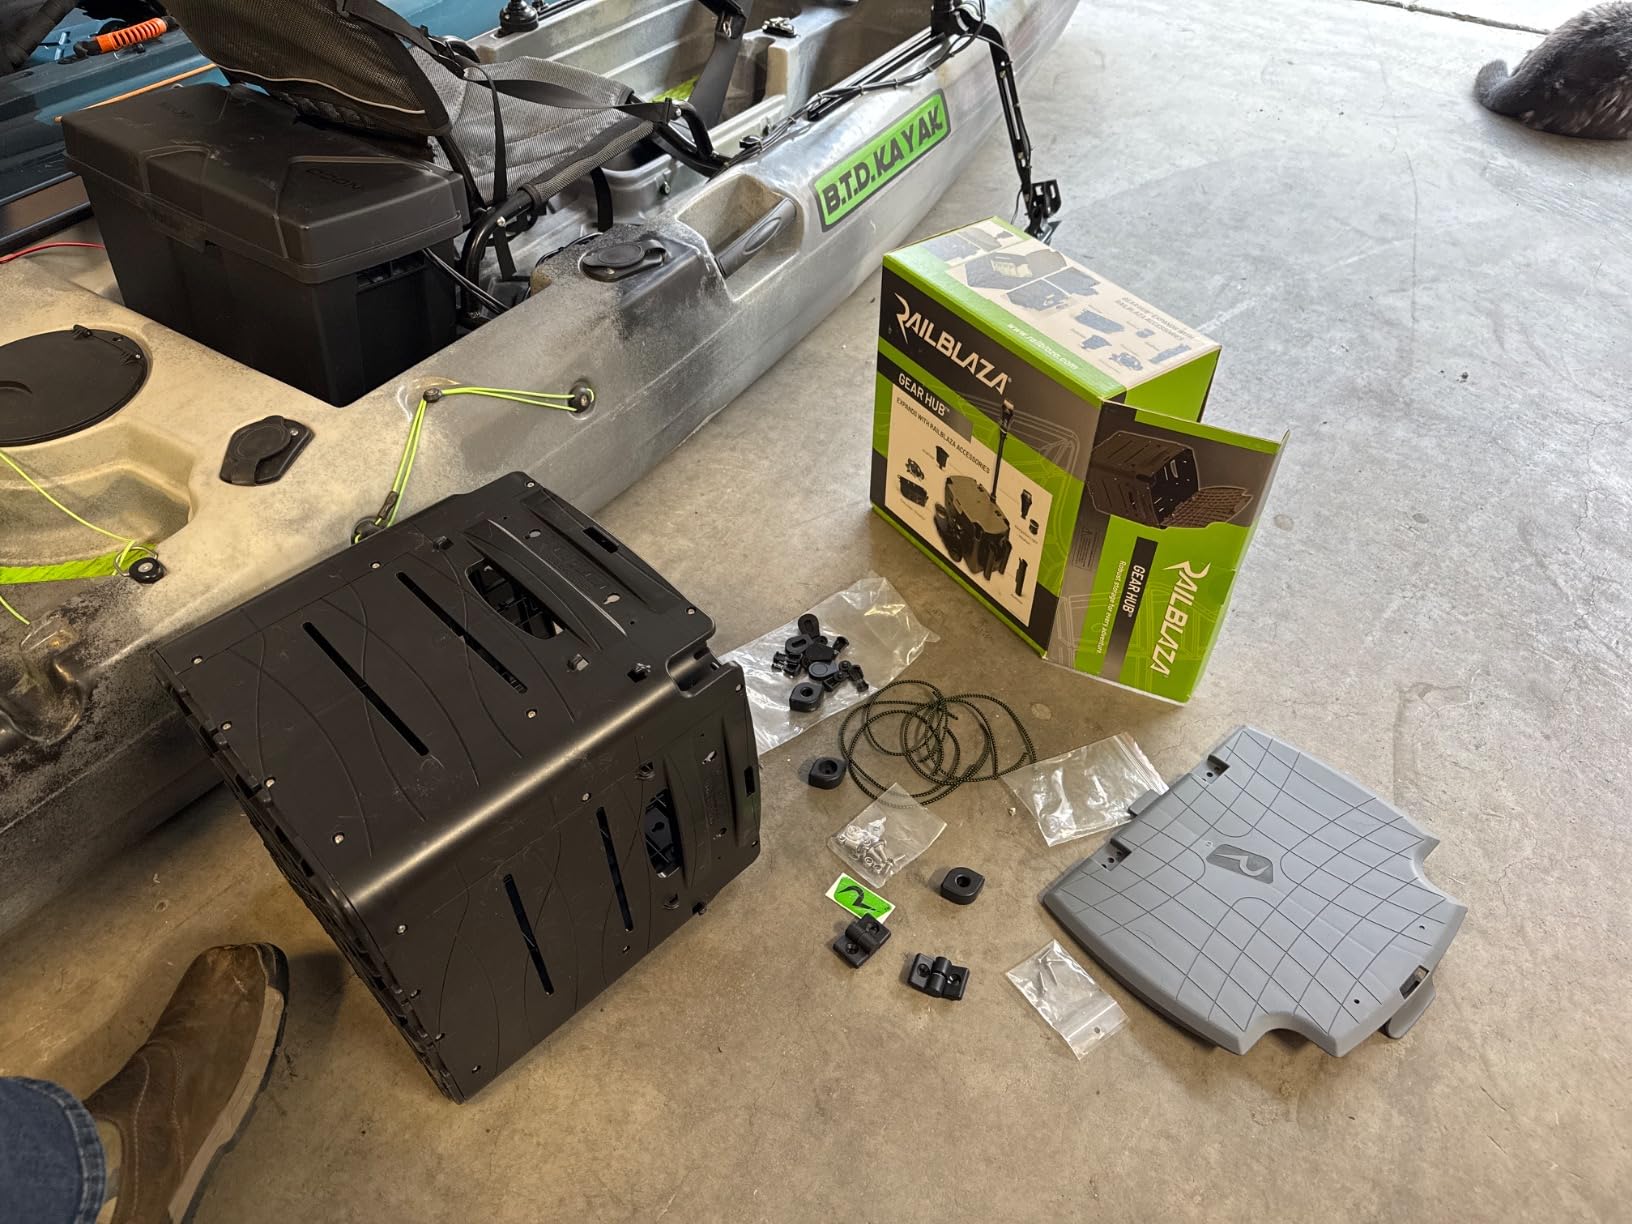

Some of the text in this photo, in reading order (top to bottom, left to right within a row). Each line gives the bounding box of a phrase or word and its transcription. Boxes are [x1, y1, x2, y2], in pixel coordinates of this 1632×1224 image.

[894, 292, 1009, 395] RAILBLAZA
[898, 373, 924, 401] GEAR
[896, 397, 918, 418] EXPANDS
[917, 413, 930, 427] WITH
[929, 422, 957, 449] RAILBLAZA
[956, 444, 991, 475] ACCESSORIES
[1114, 559, 1127, 582] Robust
[1128, 564, 1146, 593] GEAR
[1107, 580, 1120, 604] storage
[1101, 611, 1112, 628] every
[1106, 602, 1115, 613] for
[1150, 560, 1211, 677] RAILBLAZA
